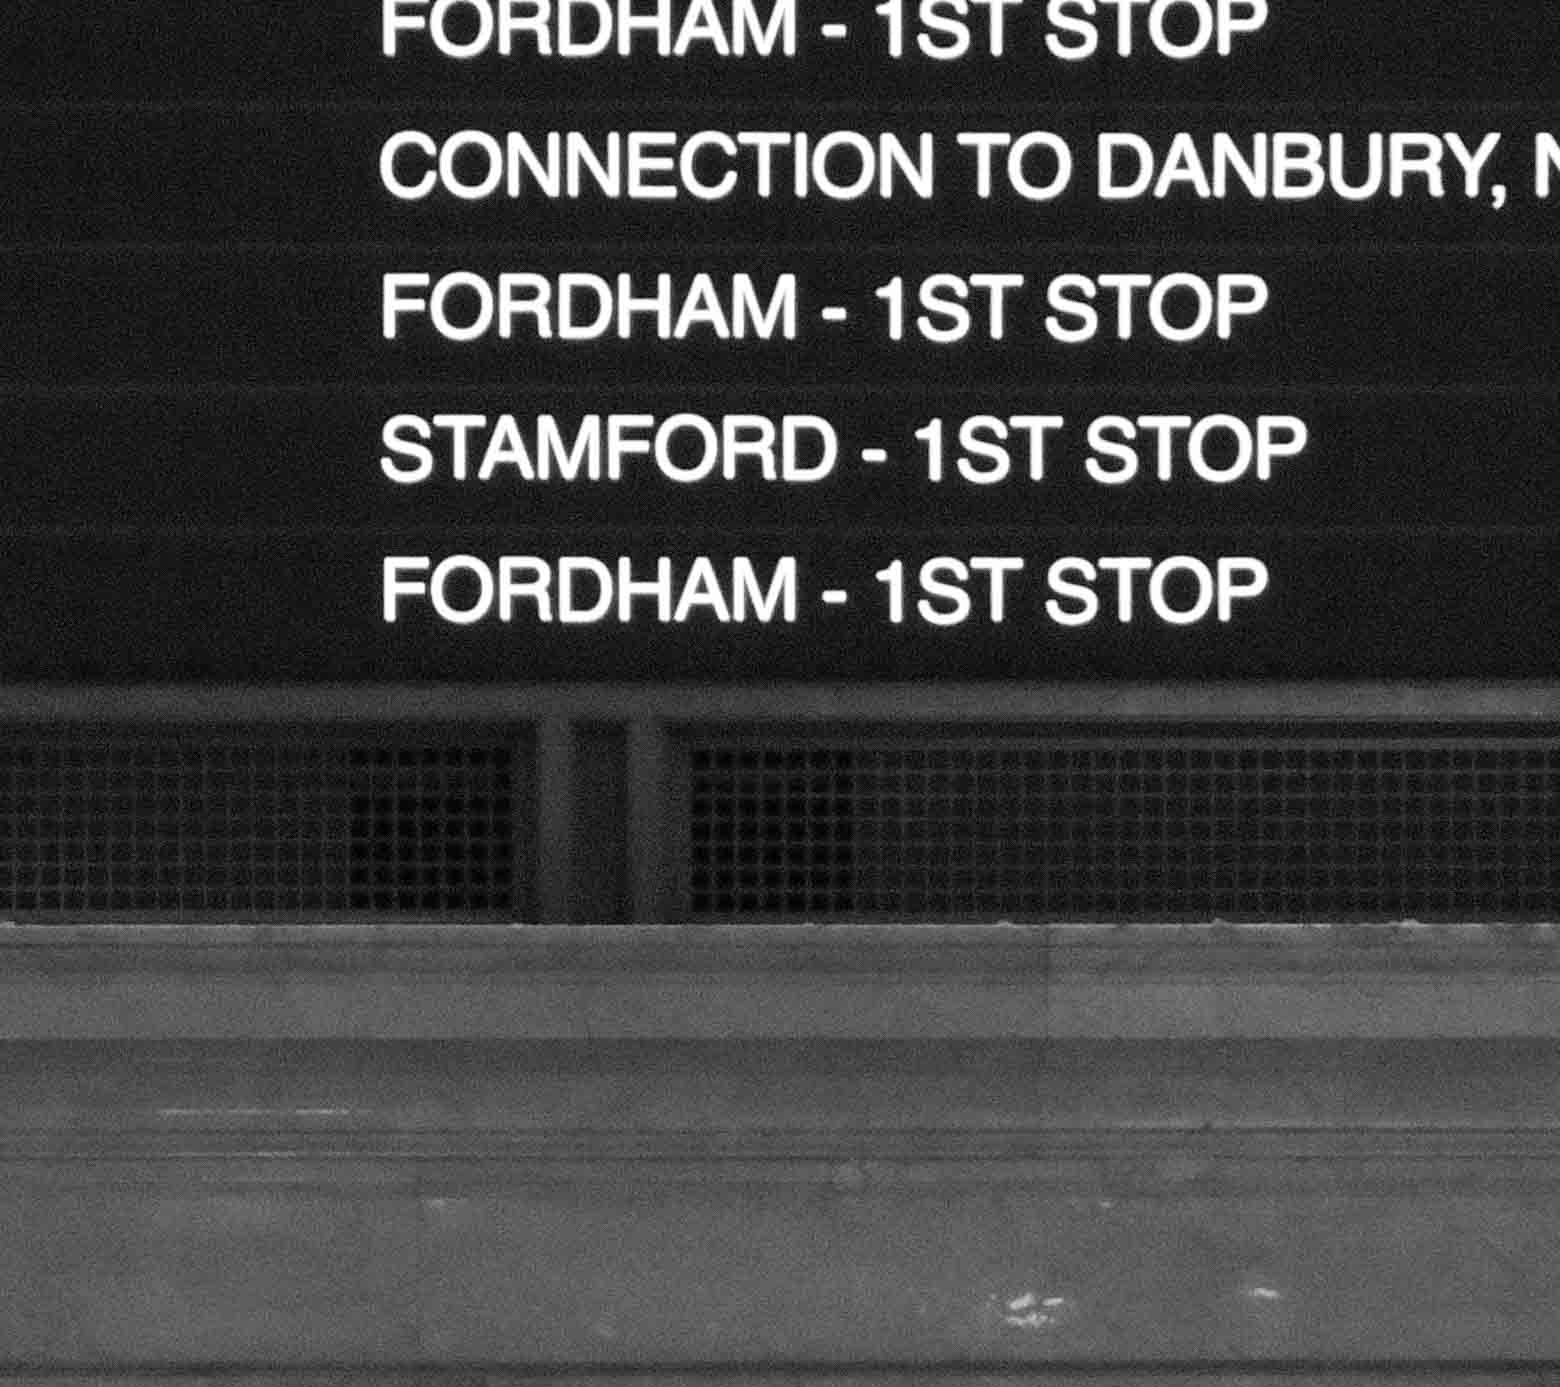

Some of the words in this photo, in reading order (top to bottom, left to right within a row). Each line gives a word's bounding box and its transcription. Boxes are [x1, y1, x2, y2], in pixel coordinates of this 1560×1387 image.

[381, 0, 798, 61] FORDHAM
[874, 0, 1025, 62] 1ST
[1043, 0, 1270, 62] STOP
[378, 128, 935, 202] CONNECTION
[955, 129, 1074, 203] TO
[1096, 130, 1508, 211] DANBURY,
[381, 269, 798, 343] FORDHAM
[874, 272, 1026, 345] 1ST
[1043, 271, 1270, 345] STOP
[378, 411, 840, 486] STAMFORD
[913, 413, 1066, 486] 1ST
[1083, 412, 1310, 486] STOP
[381, 553, 799, 626] FORDHAM
[874, 555, 1026, 628] 1ST
[1043, 554, 1271, 628] STOP
